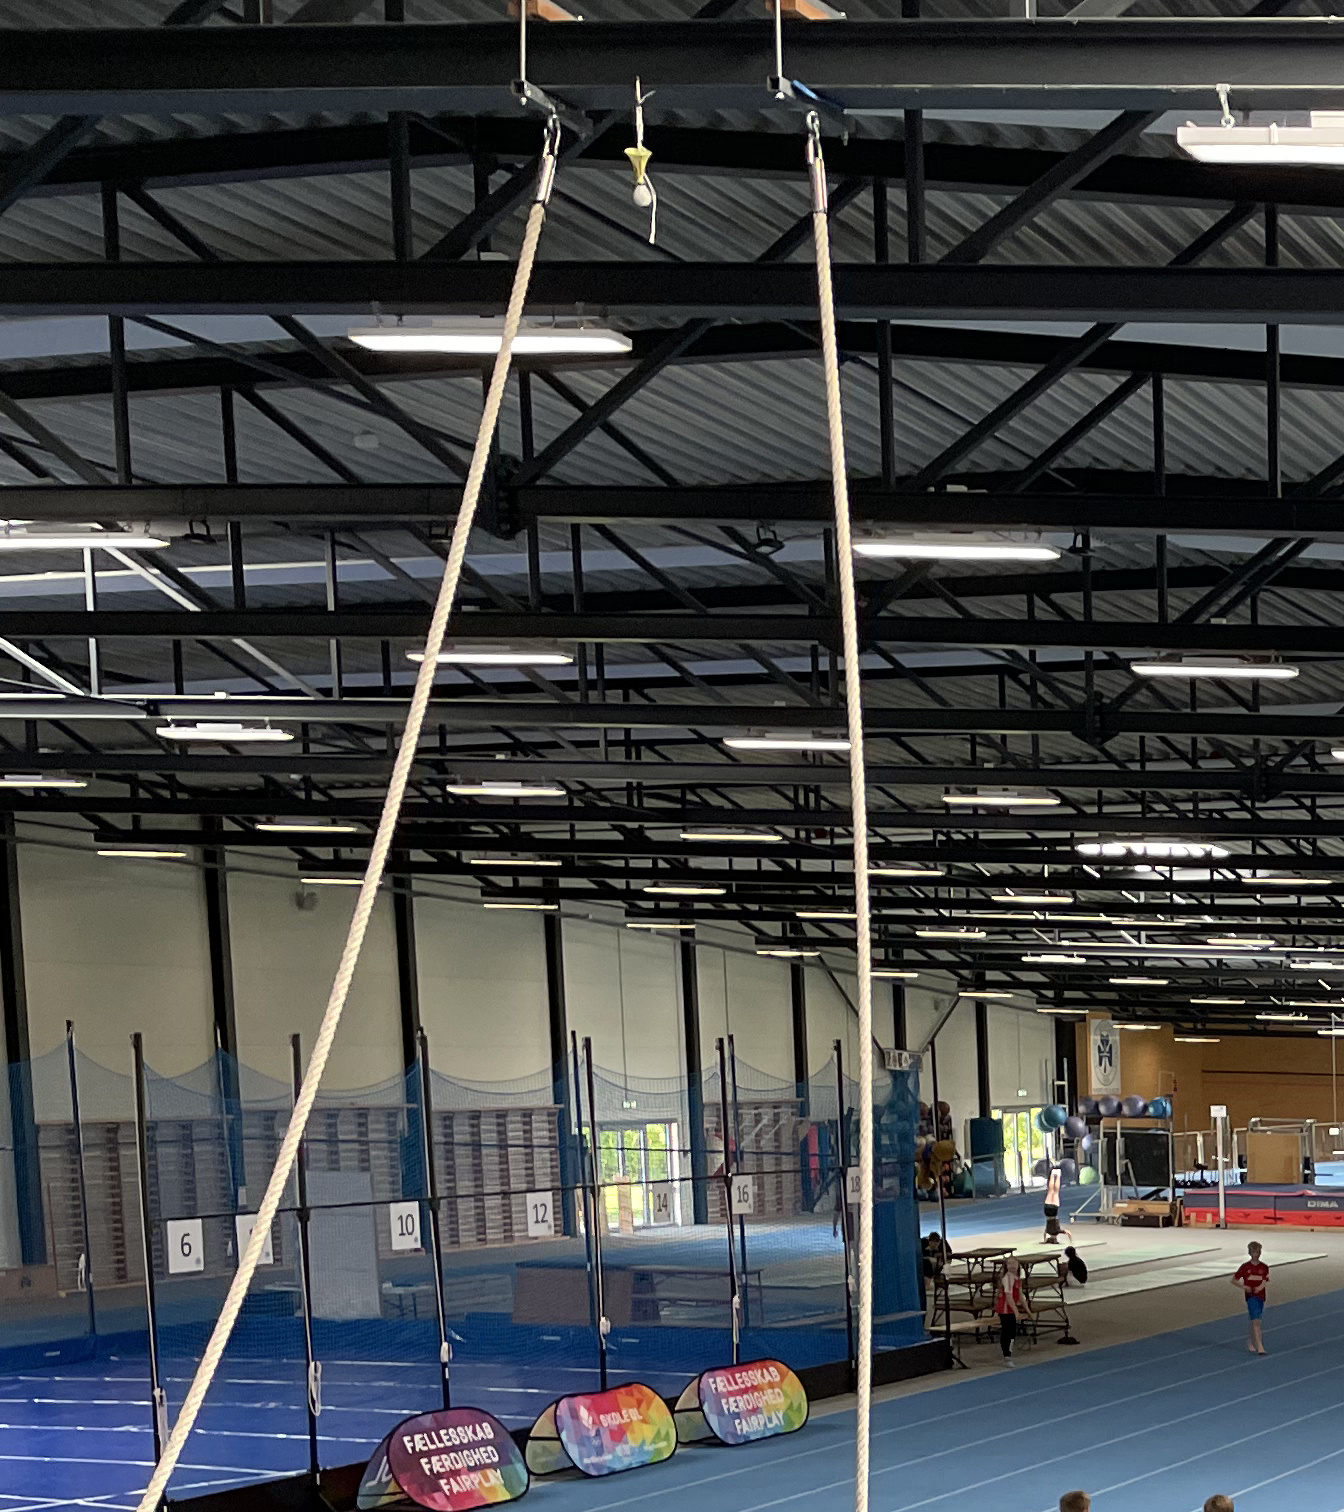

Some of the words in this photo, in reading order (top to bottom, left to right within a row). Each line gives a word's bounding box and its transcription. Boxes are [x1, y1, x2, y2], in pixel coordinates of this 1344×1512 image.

[736, 1184, 749, 1203] 16
[850, 1175, 861, 1193] 18
[533, 1202, 548, 1224] 12
[656, 1192, 669, 1212] 14
[1307, 1200, 1339, 1208] DIMA
[397, 1213, 415, 1237] 10
[180, 1232, 192, 1257] 6
[708, 1366, 781, 1395] FÆLLESSKAB
[734, 1410, 785, 1436] FAIRPLAY
[402, 1421, 495, 1455] FÆLLESSKAB
[438, 1468, 505, 1497] FAIRPLAY
